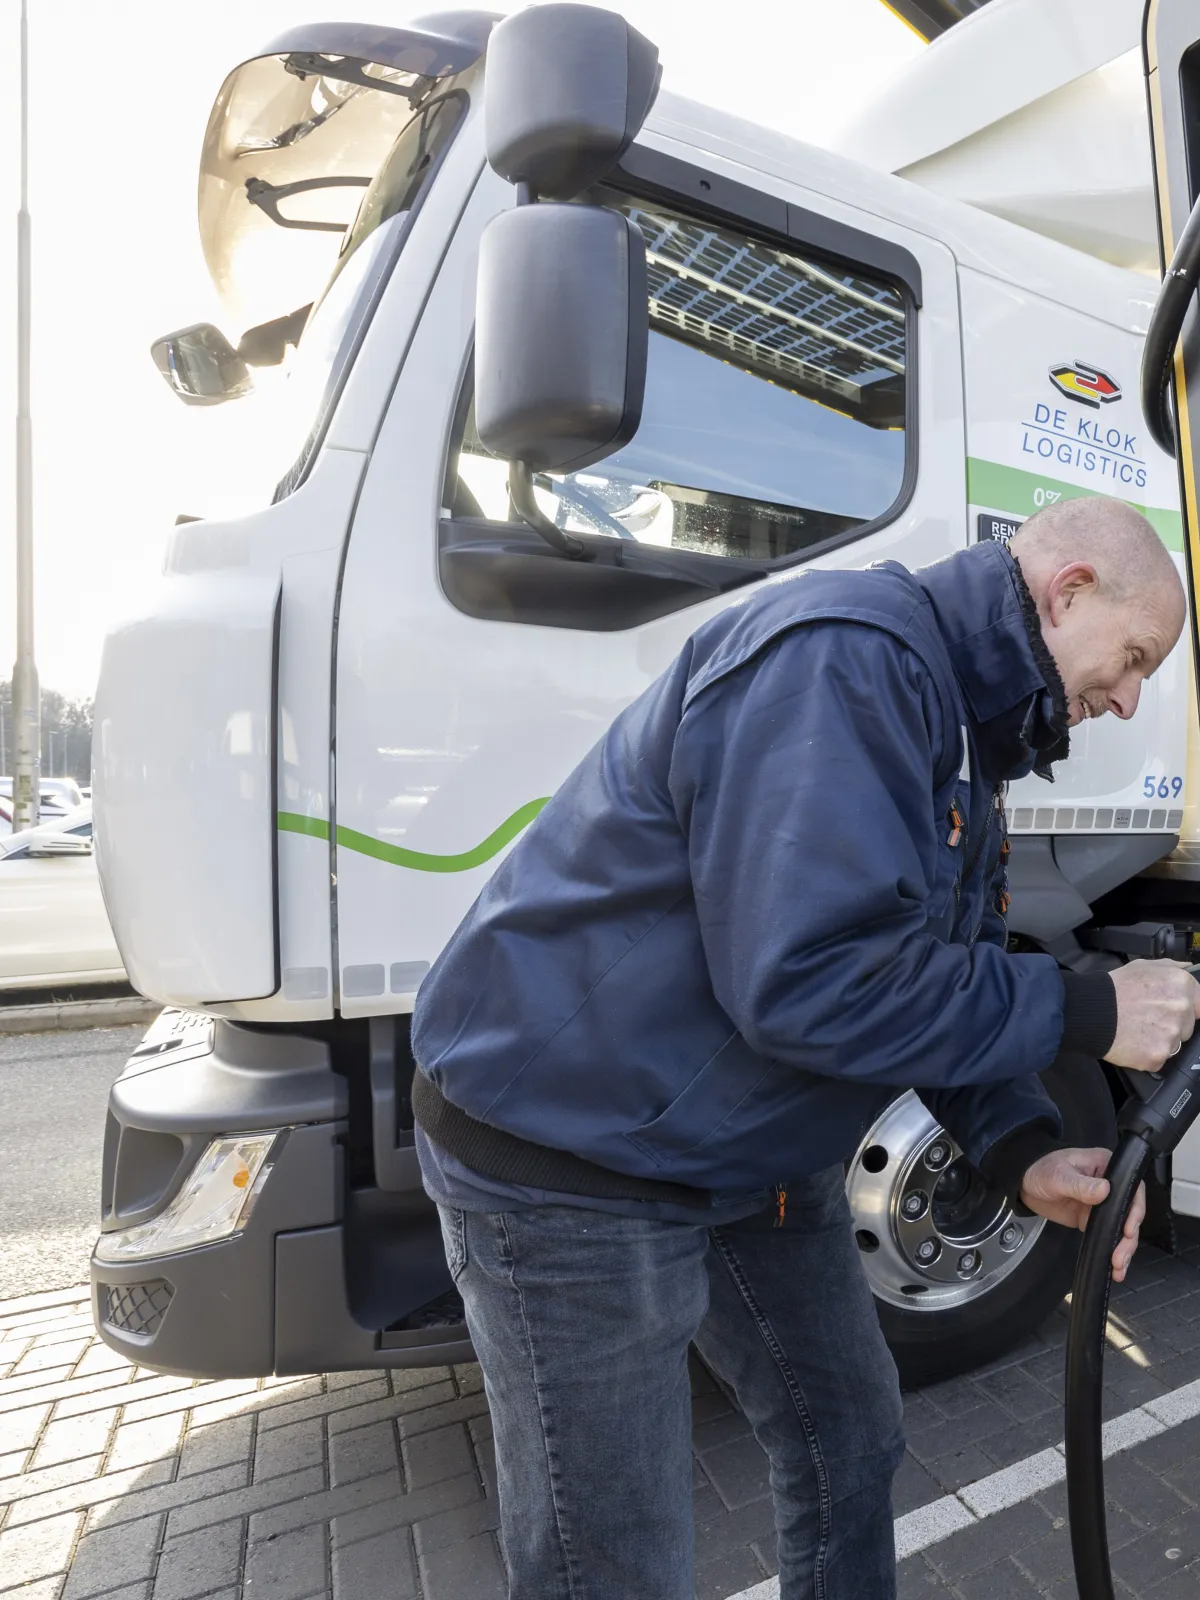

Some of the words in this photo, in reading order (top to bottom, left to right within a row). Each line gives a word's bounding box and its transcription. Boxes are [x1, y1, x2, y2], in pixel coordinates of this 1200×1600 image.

[1034, 403, 1067, 431] DE
[1077, 418, 1137, 455] KLOK
[1022, 432, 1147, 488] LOGISTICS
[1143, 775, 1183, 799] 569
